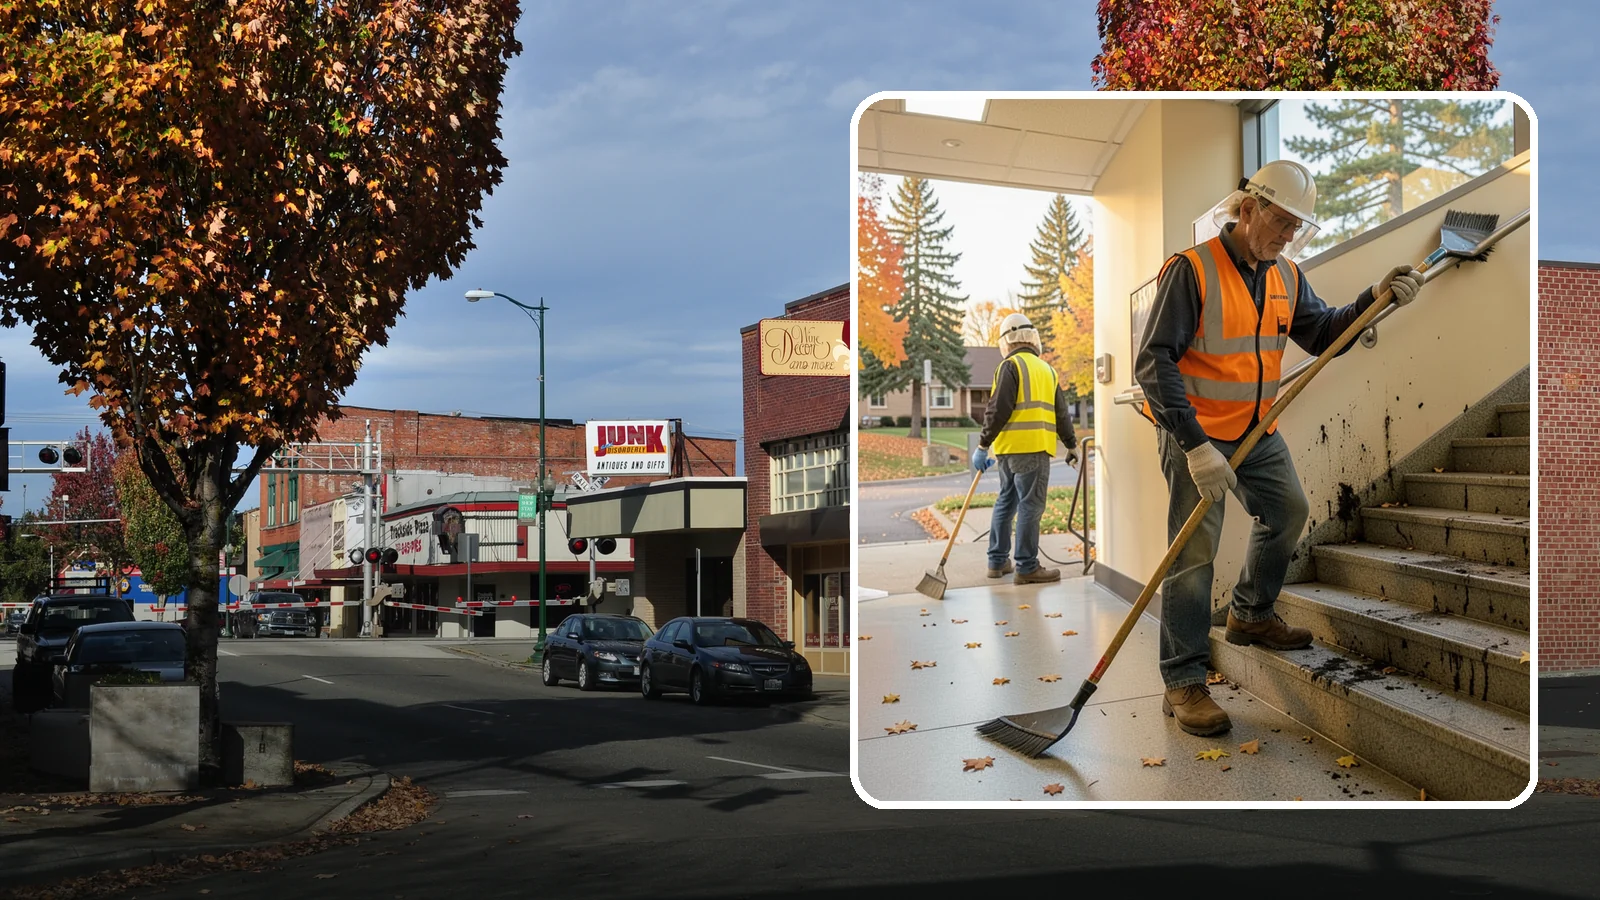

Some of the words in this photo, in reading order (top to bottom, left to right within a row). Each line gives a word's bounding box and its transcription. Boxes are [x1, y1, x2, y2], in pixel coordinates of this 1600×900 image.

[595, 425, 665, 457] JUNK
[607, 446, 646, 454] DISORDERLY
[597, 461, 628, 470] ANTIQUES
[631, 461, 644, 470] AND
[646, 460, 666, 470] GIFTS
[390, 521, 413, 540] Trackside
[414, 519, 429, 535] Pizza
